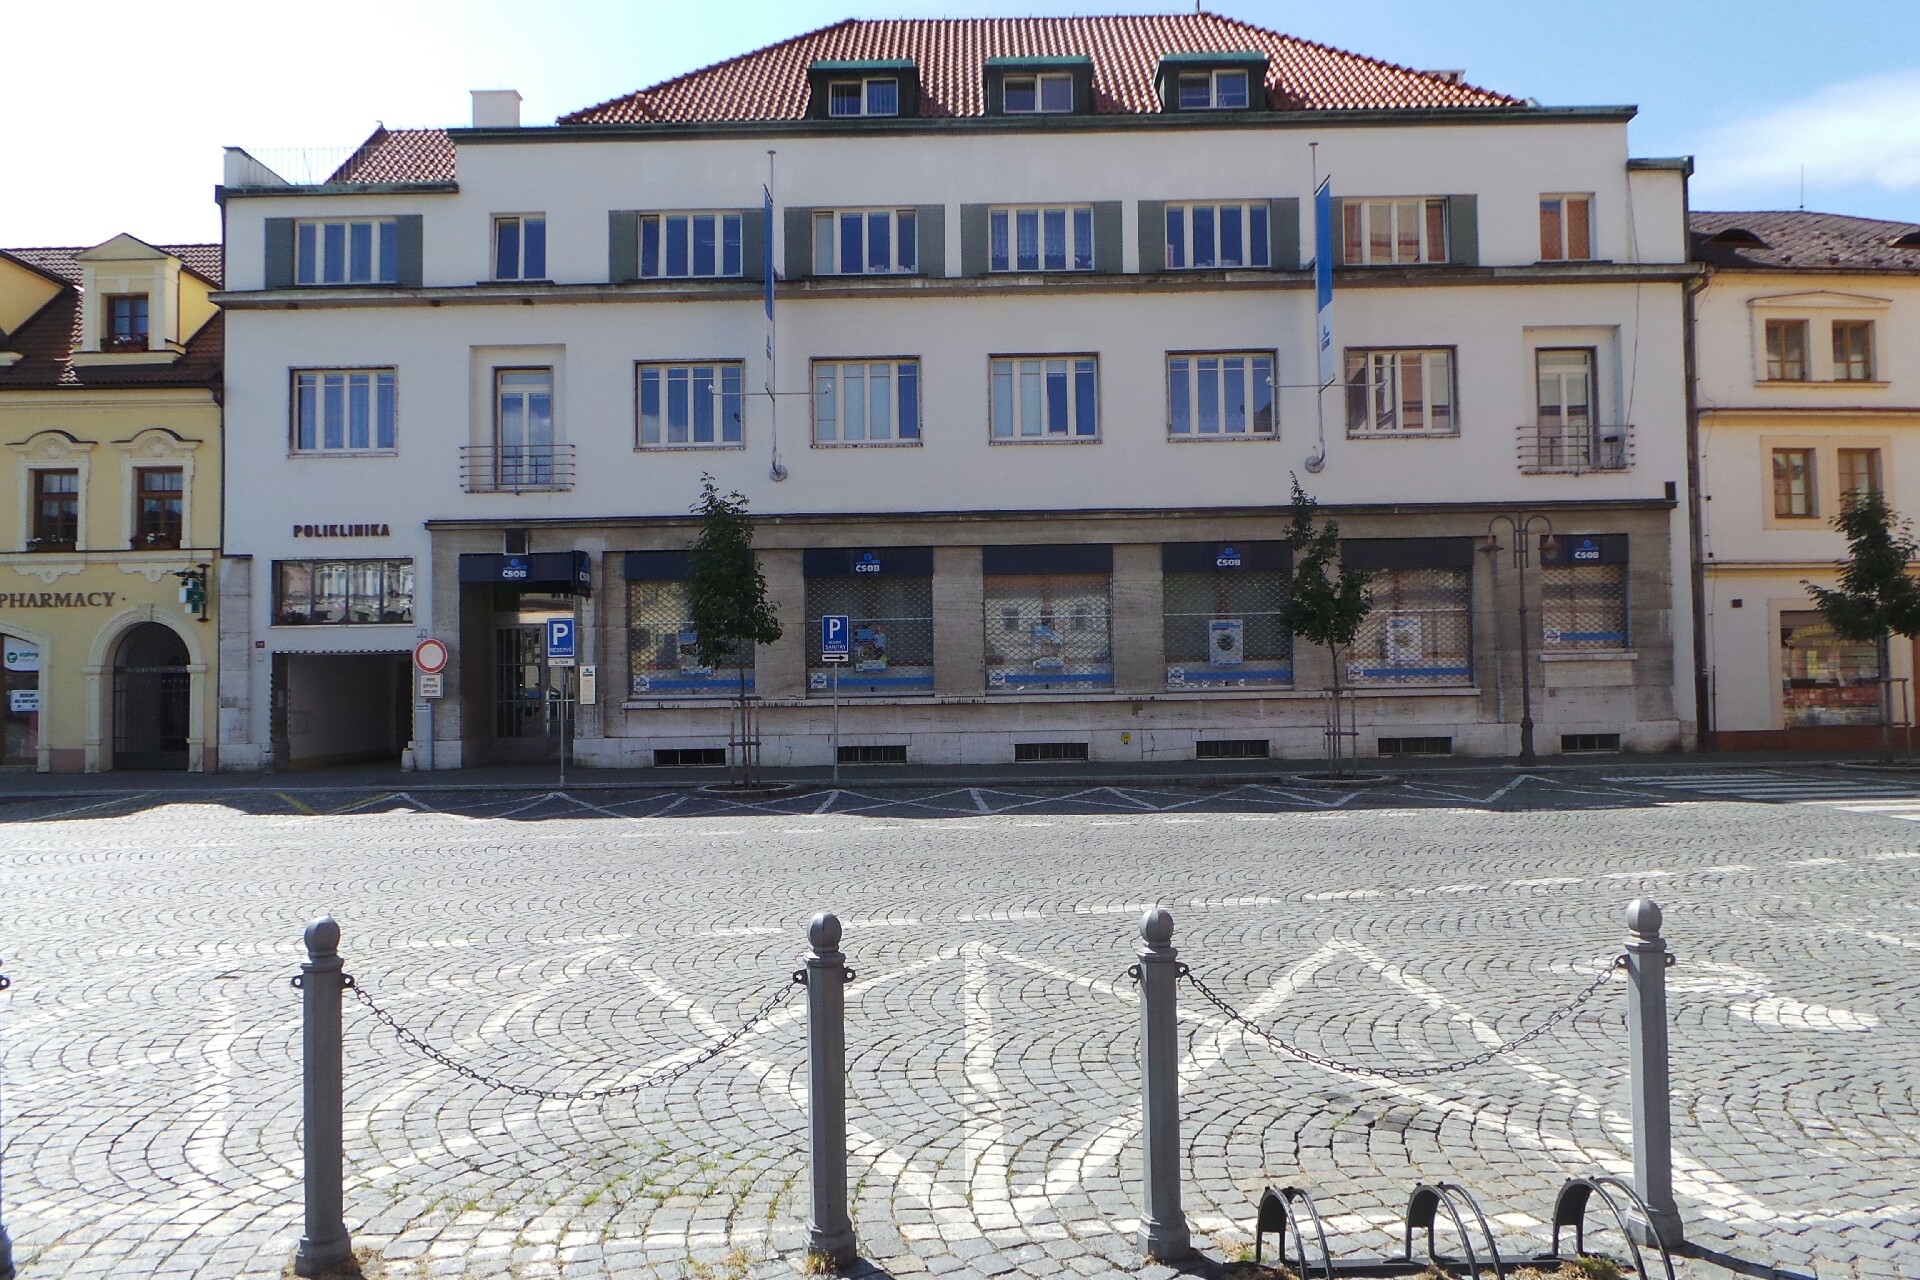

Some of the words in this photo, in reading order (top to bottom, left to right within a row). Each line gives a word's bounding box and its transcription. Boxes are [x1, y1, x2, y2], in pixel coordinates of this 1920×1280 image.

[293, 524, 390, 538] POLIKLINIKA
[502, 569, 527, 578] ČSOB
[0, 592, 116, 608] PHARMACY
[552, 623, 569, 646] P
[830, 618, 841, 639] P
